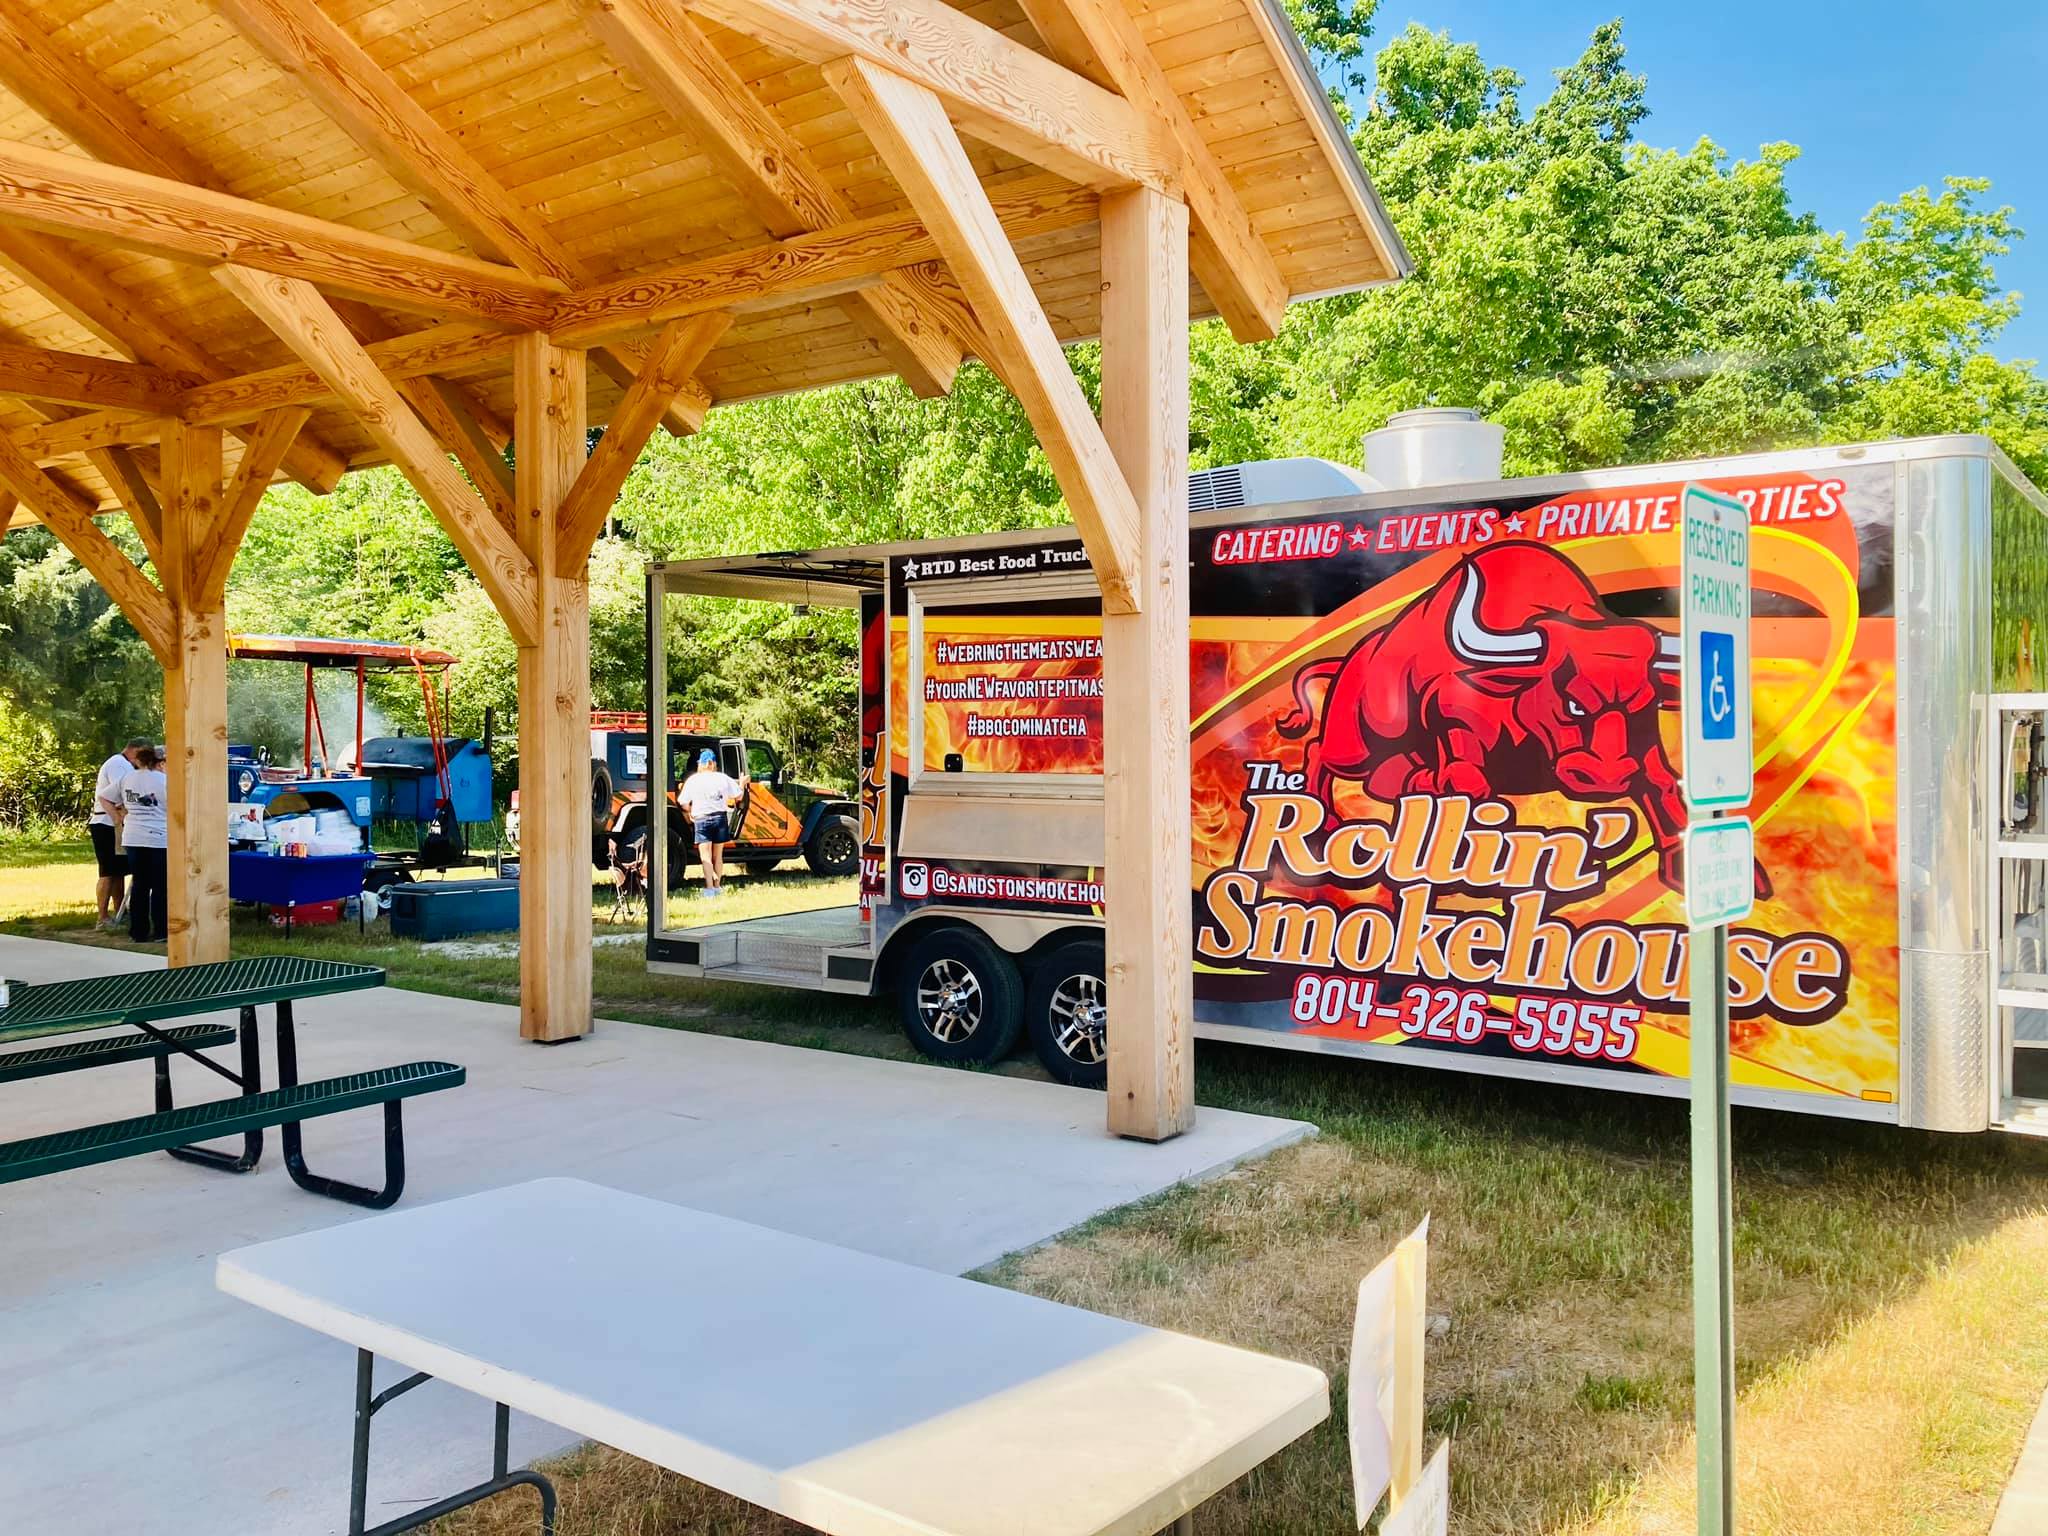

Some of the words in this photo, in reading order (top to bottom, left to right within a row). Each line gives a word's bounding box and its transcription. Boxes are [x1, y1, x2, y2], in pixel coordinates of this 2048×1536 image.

[1213, 524, 1342, 562] CATERING
[1377, 510, 1499, 550] EVENTS
[1537, 496, 1677, 538] PRIVATE
[1688, 518, 1745, 567] RESERVED
[921, 559, 955, 576] RTD
[960, 558, 995, 573] Best
[999, 554, 1036, 570] Food
[1692, 574, 1742, 618] PARKING
[968, 714, 1087, 737] #BBQCOMINATCHA
[1246, 763, 1305, 790] The
[1239, 793, 1631, 891] Rollin'
[1197, 872, 1843, 1013] Smokehouse
[1294, 975, 1641, 1059] 804-326-5955
